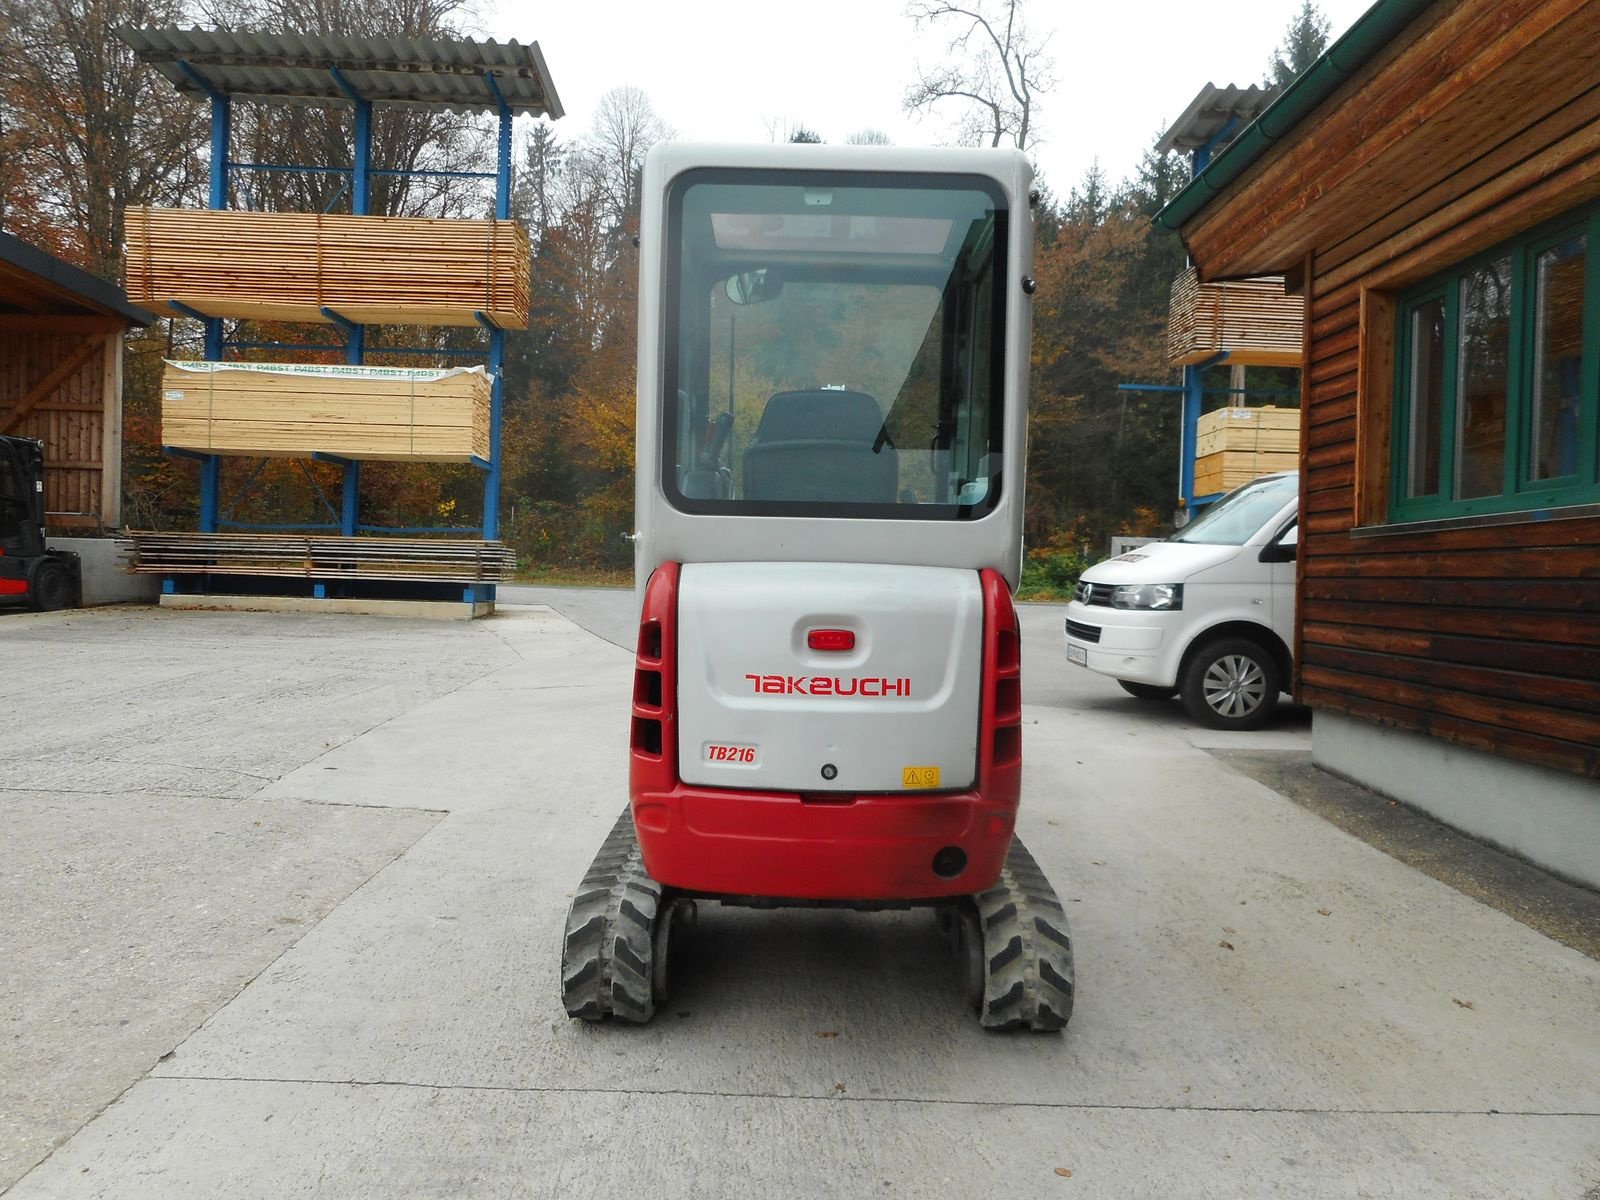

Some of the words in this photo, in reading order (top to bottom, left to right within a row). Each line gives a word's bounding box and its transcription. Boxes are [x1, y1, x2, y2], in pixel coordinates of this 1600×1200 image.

[256, 364, 291, 372] PABST
[294, 365, 329, 374] PABST
[331, 366, 367, 375] PABST
[369, 368, 403, 376] PABST
[708, 745, 756, 763] TB216
